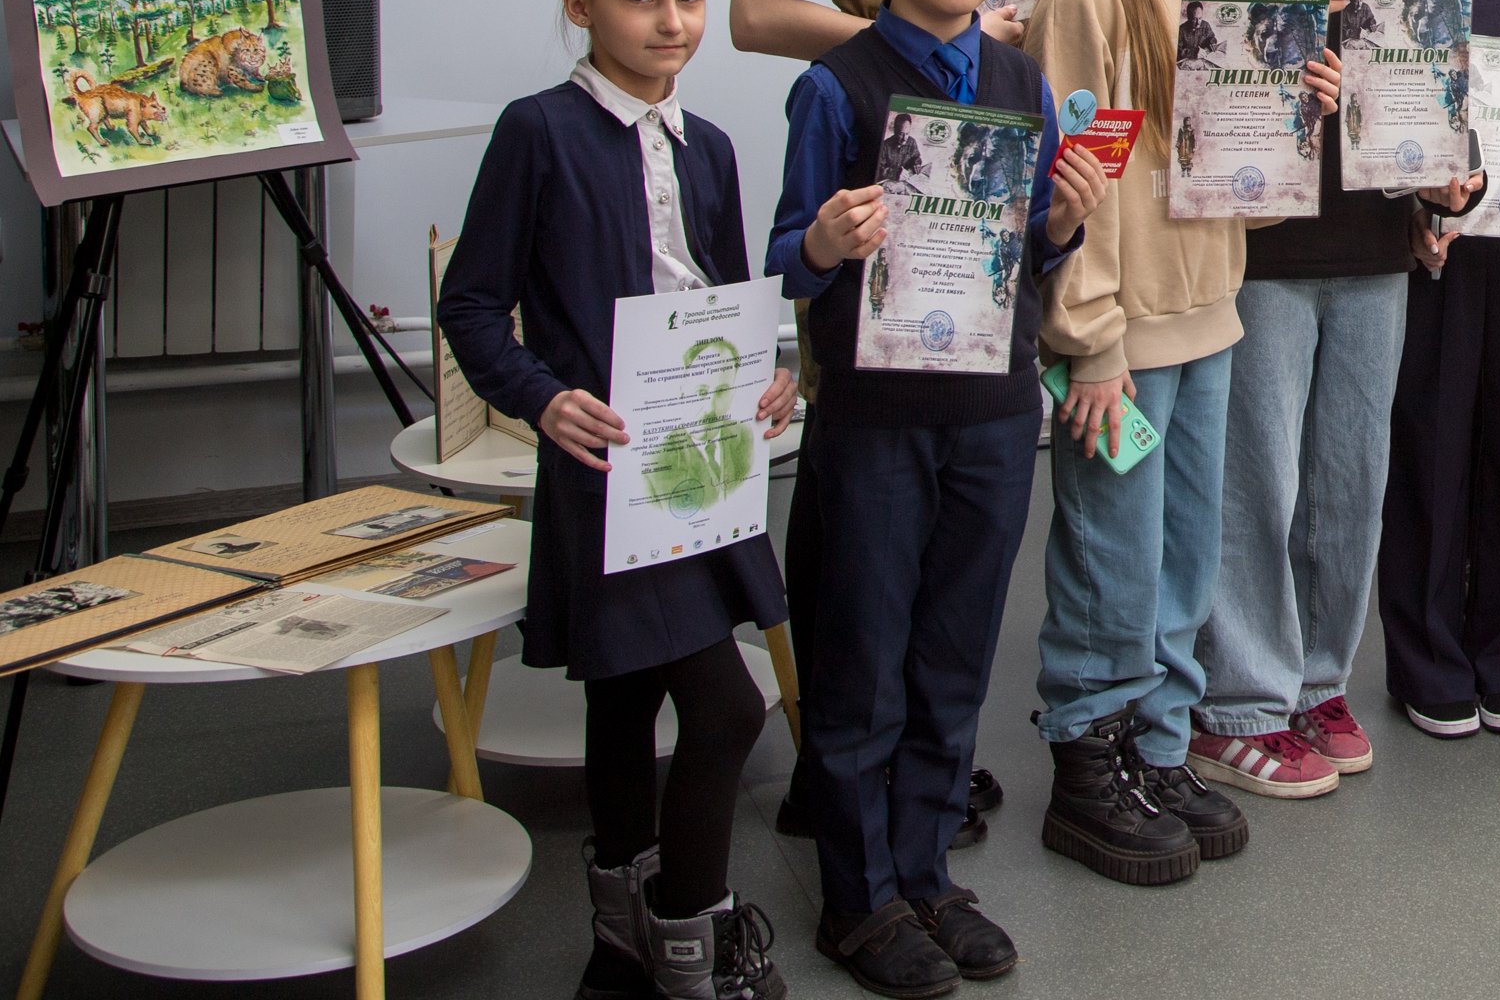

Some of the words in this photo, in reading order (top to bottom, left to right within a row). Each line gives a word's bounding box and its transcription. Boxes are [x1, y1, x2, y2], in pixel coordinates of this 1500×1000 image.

[1368, 49, 1449, 65] ДИПЛОМ
[1206, 69, 1300, 87] ДИПЛОМ
[1253, 130, 1294, 139] Елизавета
[905, 194, 1005, 221] ДИПЛОМ
[929, 221, 938, 230] III
[940, 222, 976, 234] СТЕПЕНИ
[911, 267, 942, 278] Фирсов
[943, 270, 975, 279] Арсений
[682, 316, 710, 326] Григория
[710, 311, 741, 321] Федосеева
[684, 309, 706, 319] Тропой
[706, 304, 740, 316] испытаний
[694, 336, 724, 347] ДИПЛОМ
